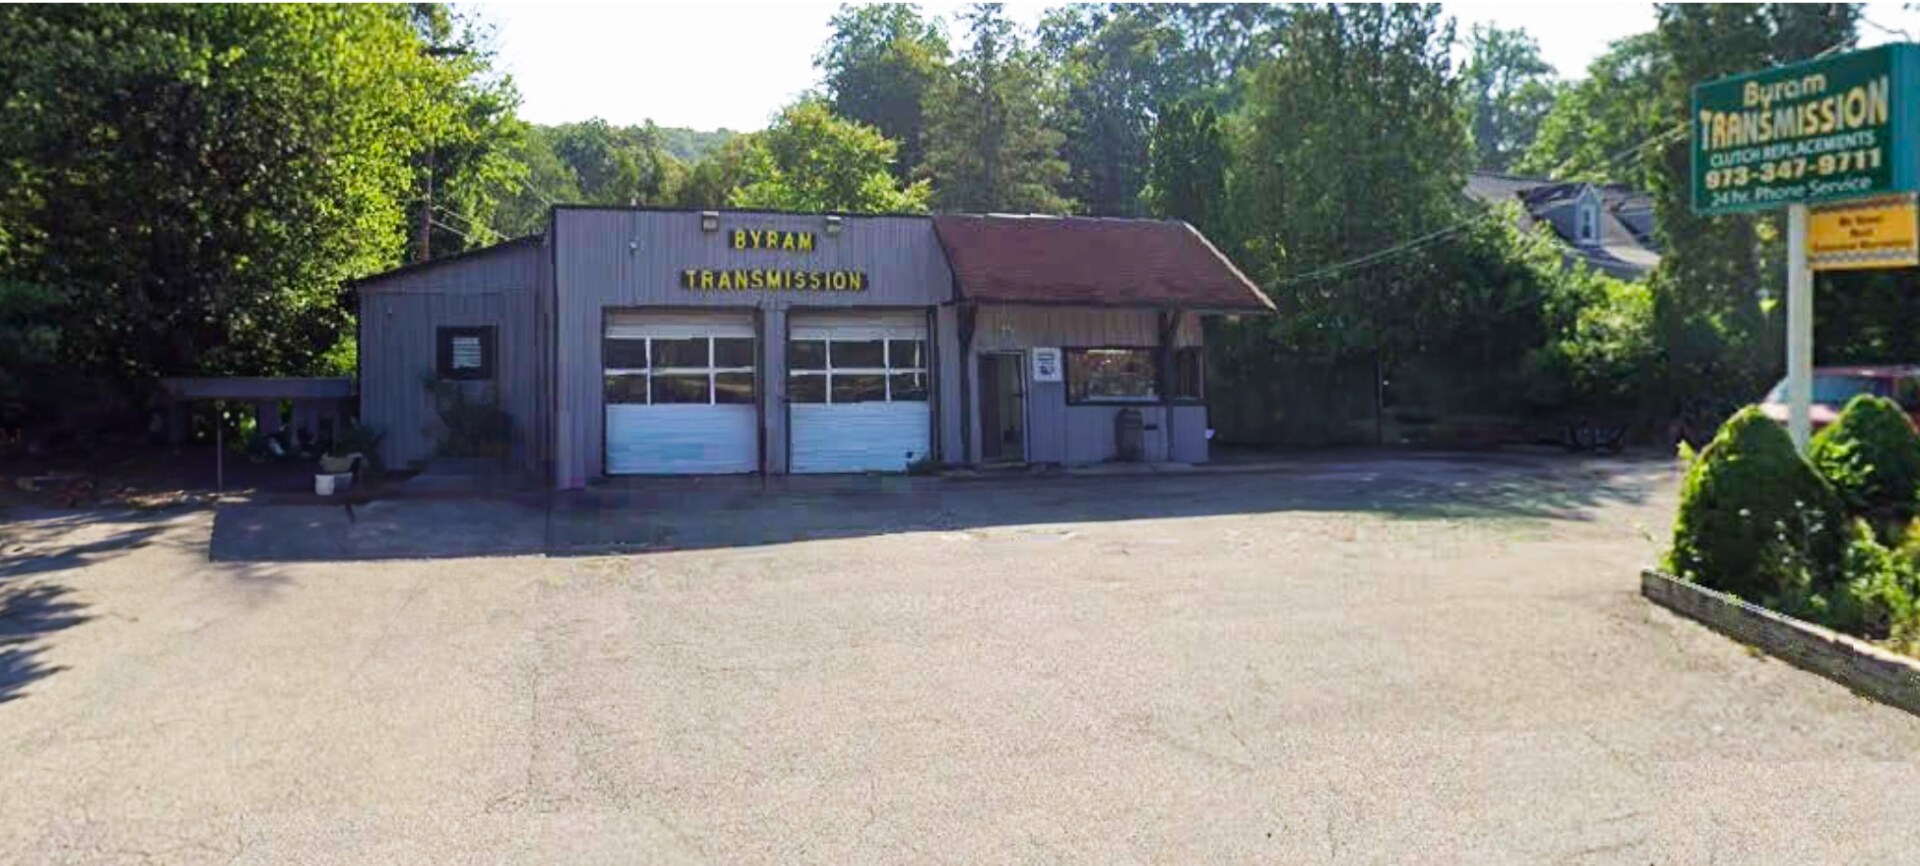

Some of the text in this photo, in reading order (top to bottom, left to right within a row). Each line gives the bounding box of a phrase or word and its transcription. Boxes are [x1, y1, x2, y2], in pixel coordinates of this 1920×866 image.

[1743, 74, 1826, 109] Byram
[1699, 75, 1889, 150] TRANSMISSION
[1710, 130, 1876, 167] CLUTCH REPLACEMENTS
[1705, 148, 1882, 190] 973-347-9711
[1711, 192, 1730, 207] 24
[1755, 184, 1806, 201] Phone
[1808, 176, 1873, 196] Service
[734, 230, 813, 251] BYRAM
[685, 270, 862, 291] TRANSMISSION
